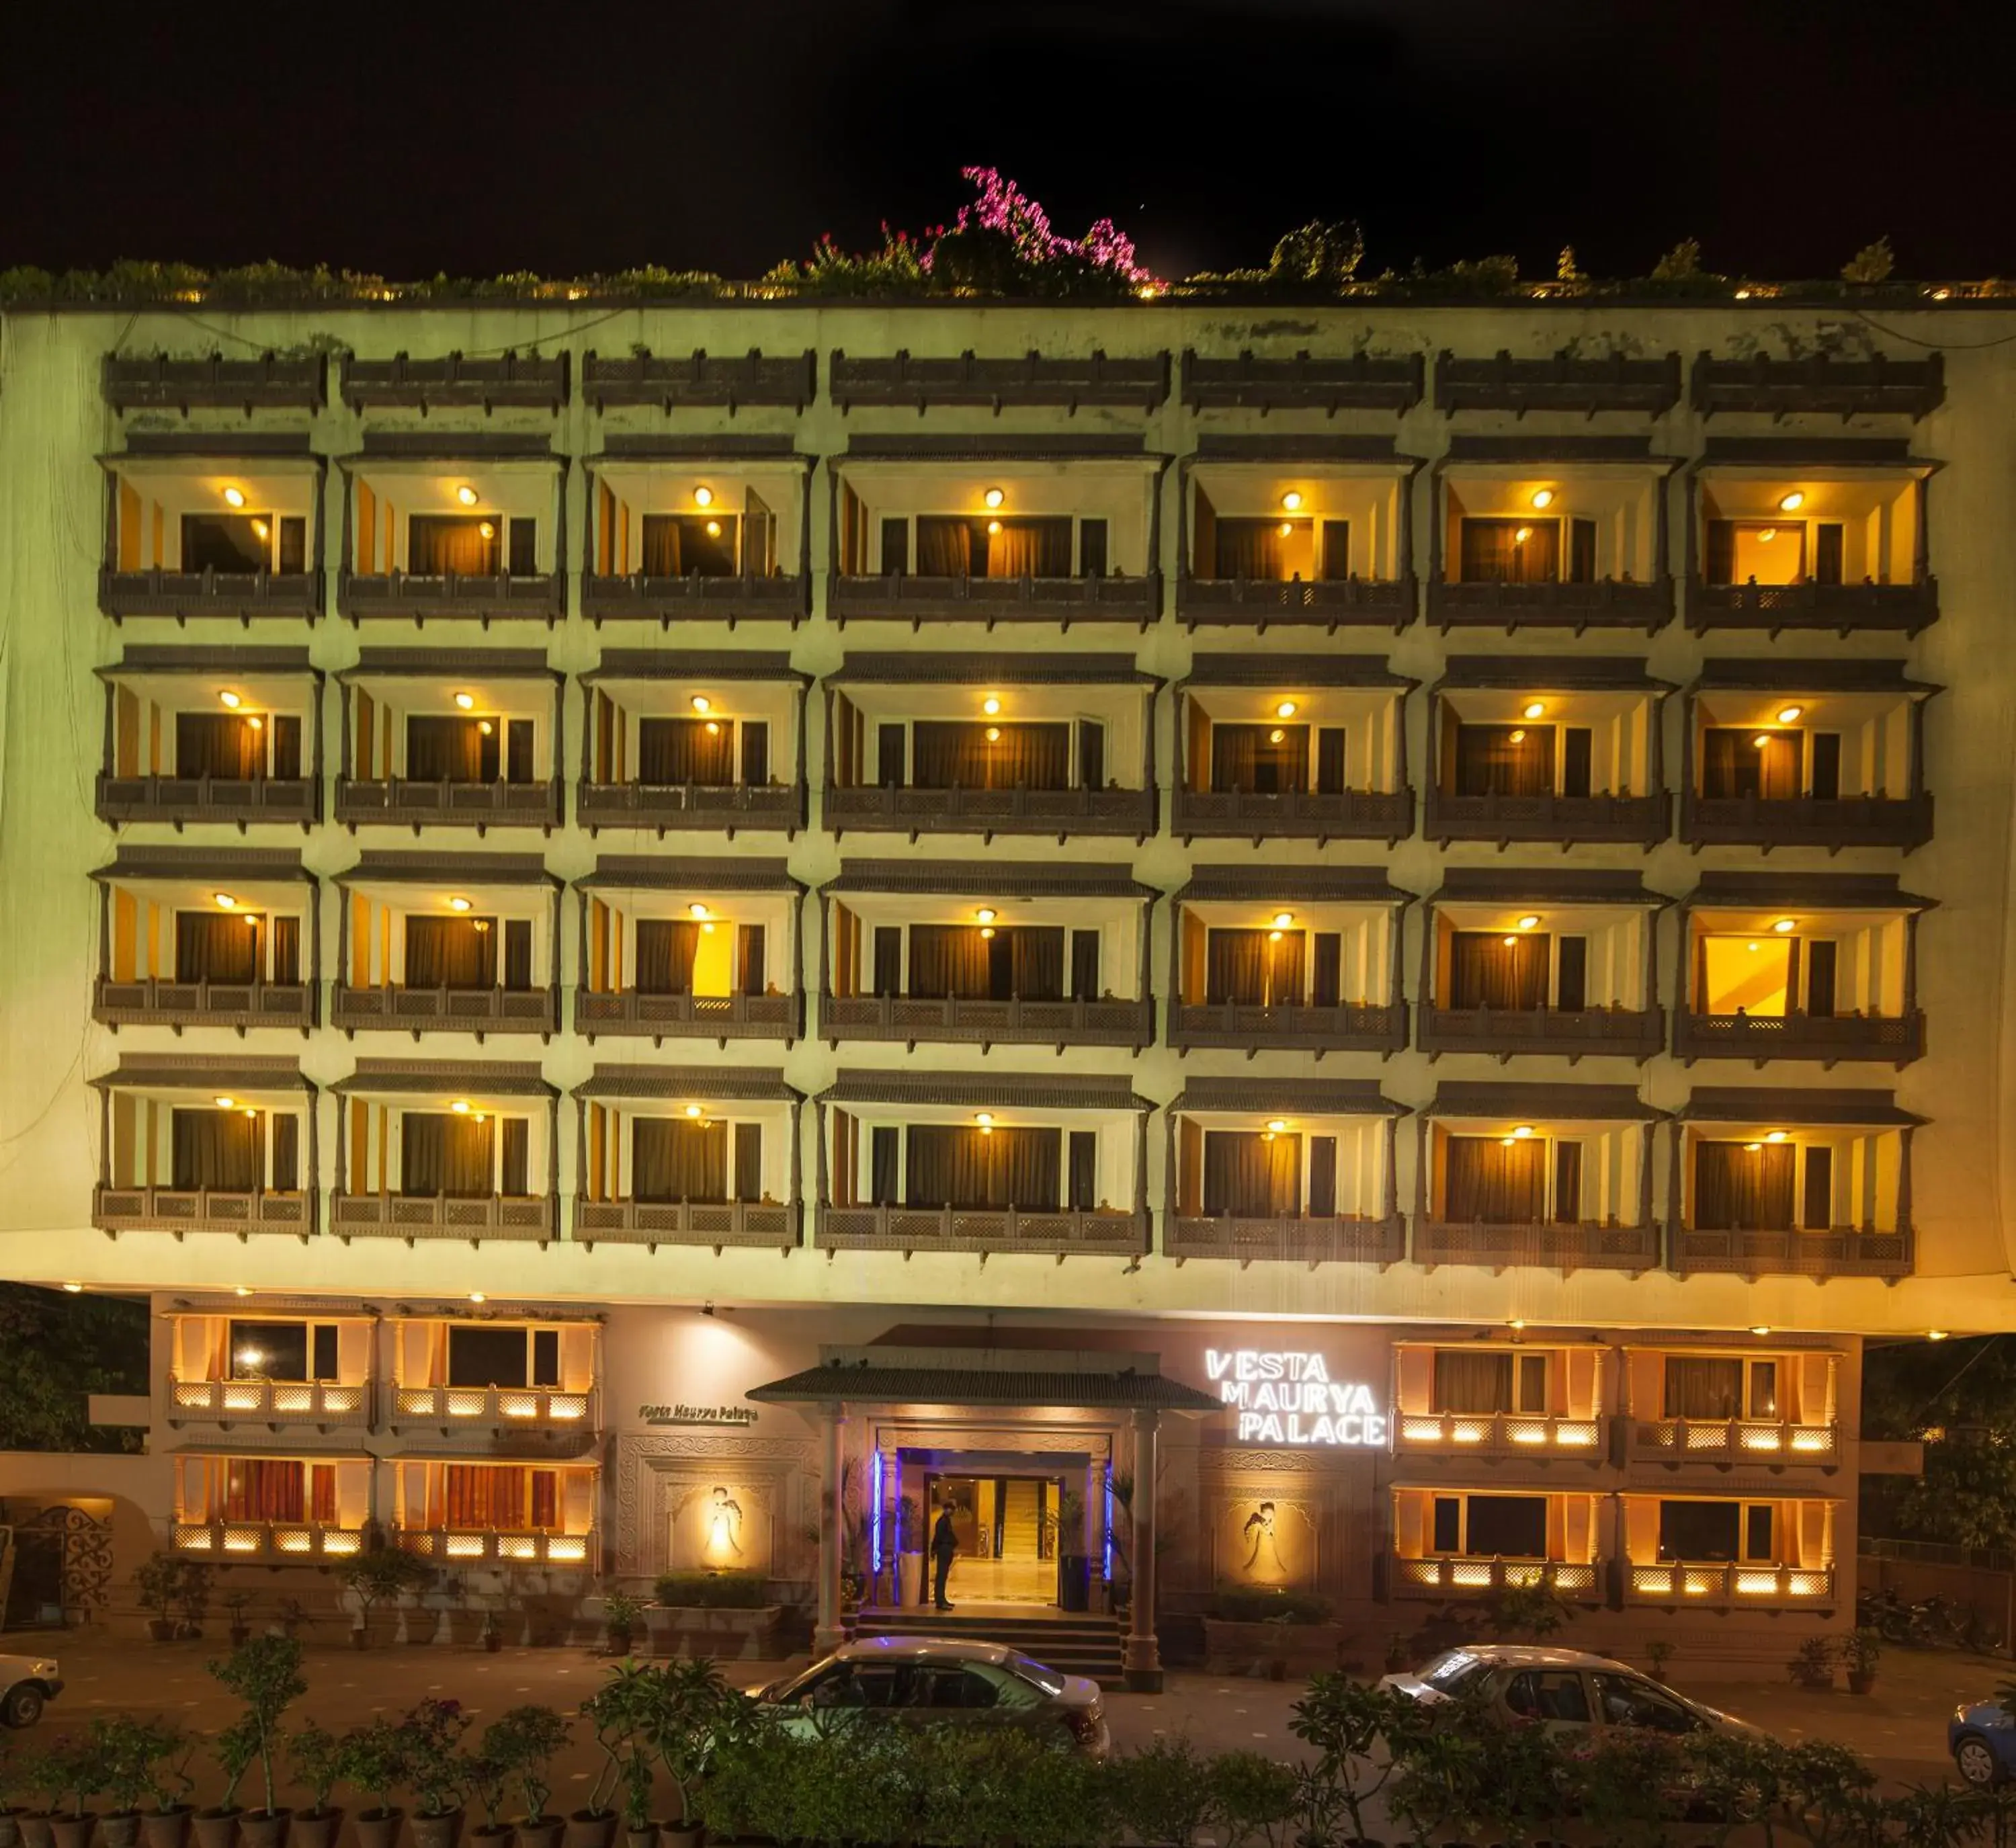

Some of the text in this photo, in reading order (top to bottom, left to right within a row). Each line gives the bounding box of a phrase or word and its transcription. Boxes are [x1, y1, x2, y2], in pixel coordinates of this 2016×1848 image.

[1205, 1349, 1329, 1382] VESTA
[1221, 1381, 1376, 1414] MAURYA
[1238, 1412, 1386, 1445] PALACE
